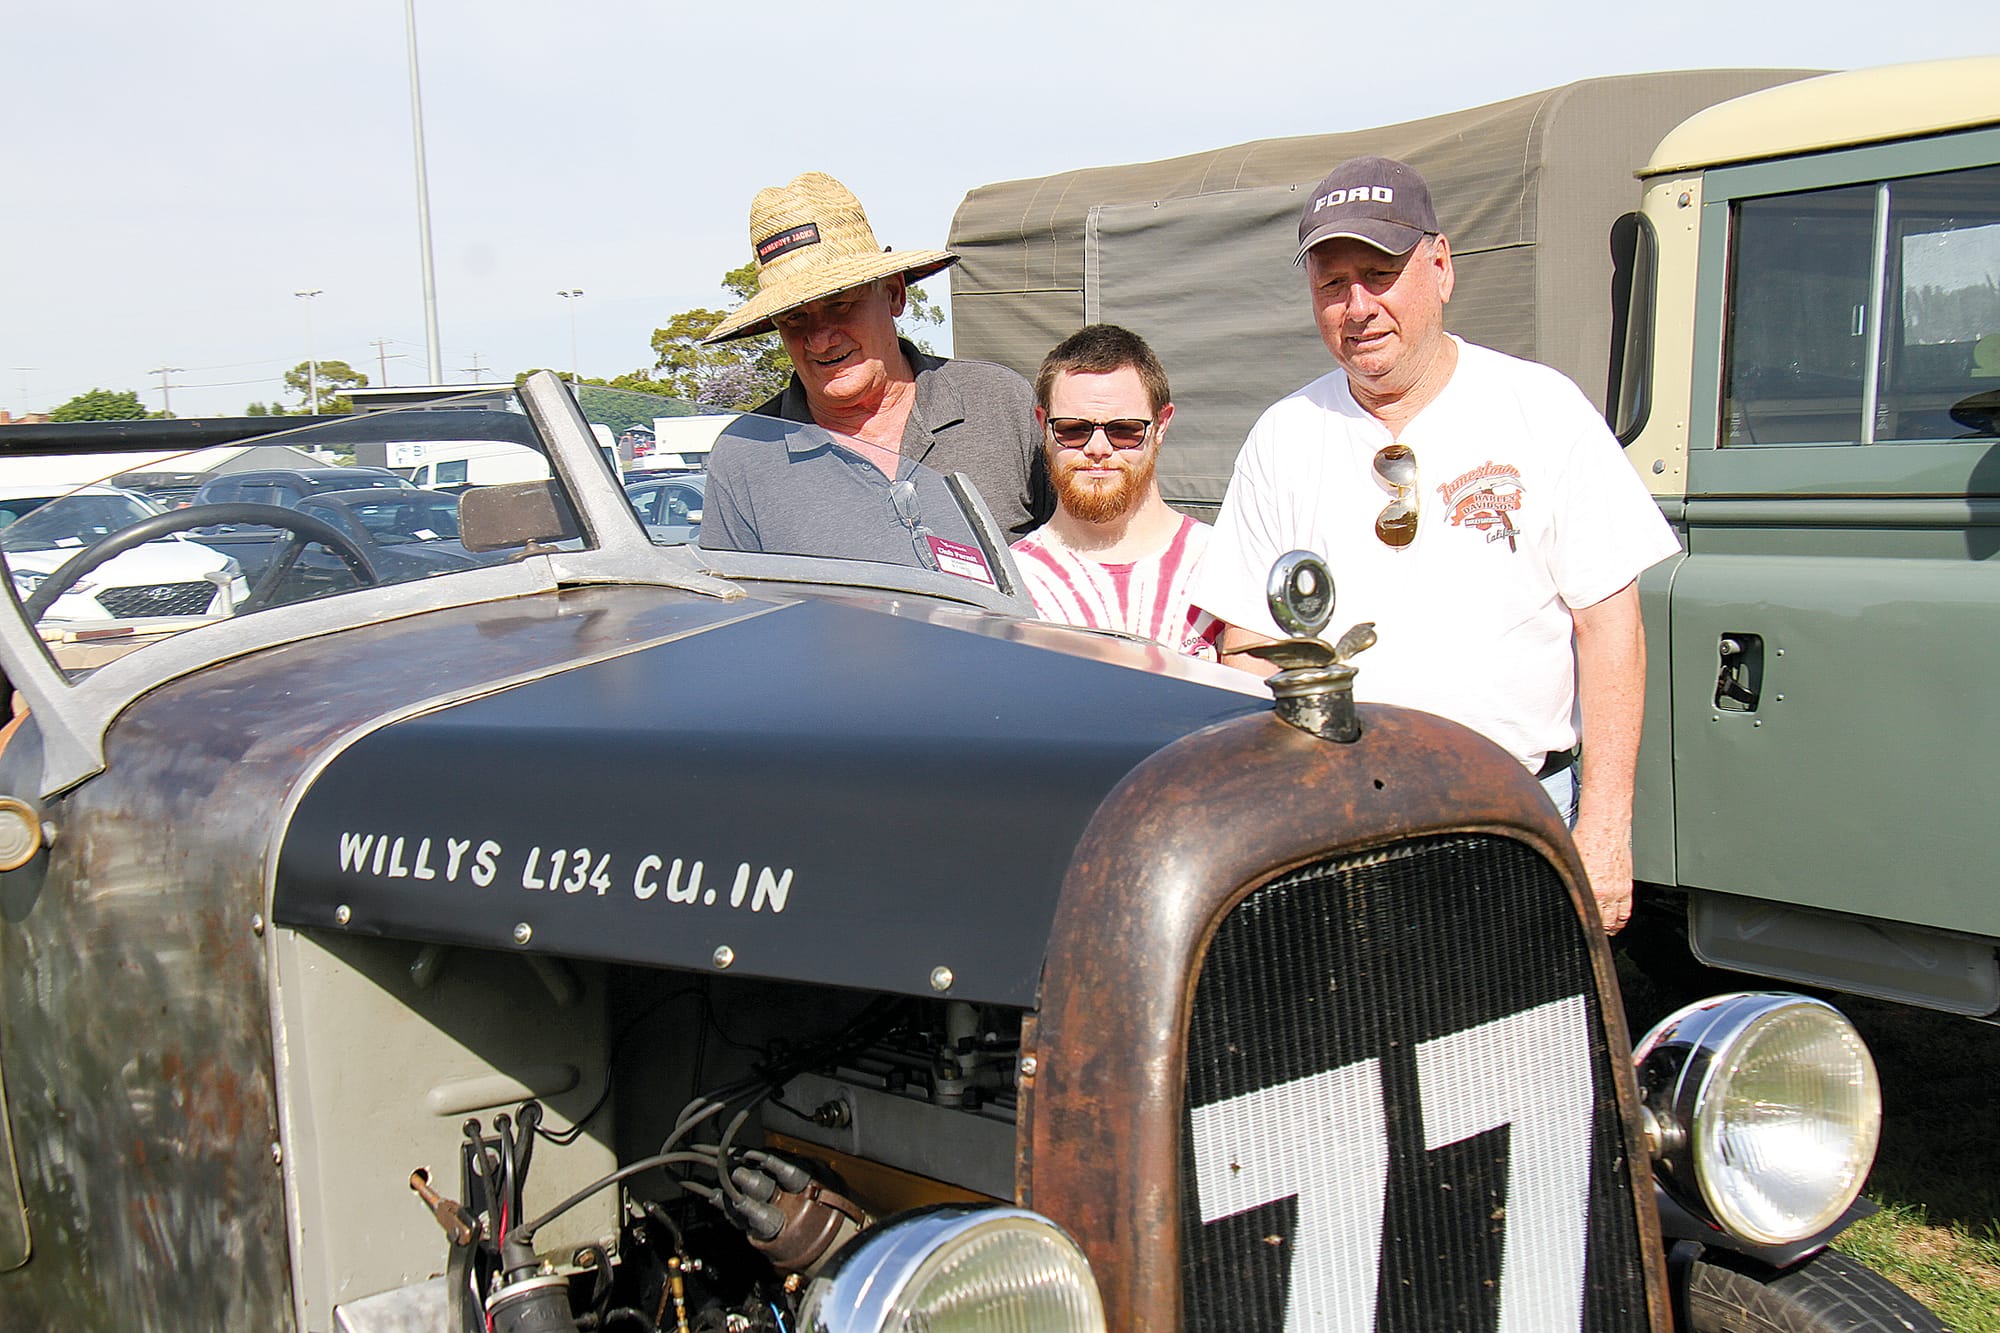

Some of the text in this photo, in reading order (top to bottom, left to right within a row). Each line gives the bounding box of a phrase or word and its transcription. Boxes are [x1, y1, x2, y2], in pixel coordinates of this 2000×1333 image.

[1314, 185, 1394, 213] FORD
[1463, 502, 1514, 514] DAVIDSON
[1475, 494, 1515, 502] HARLEY
[340, 831, 502, 888] WILLYS
[522, 846, 612, 896] L134
